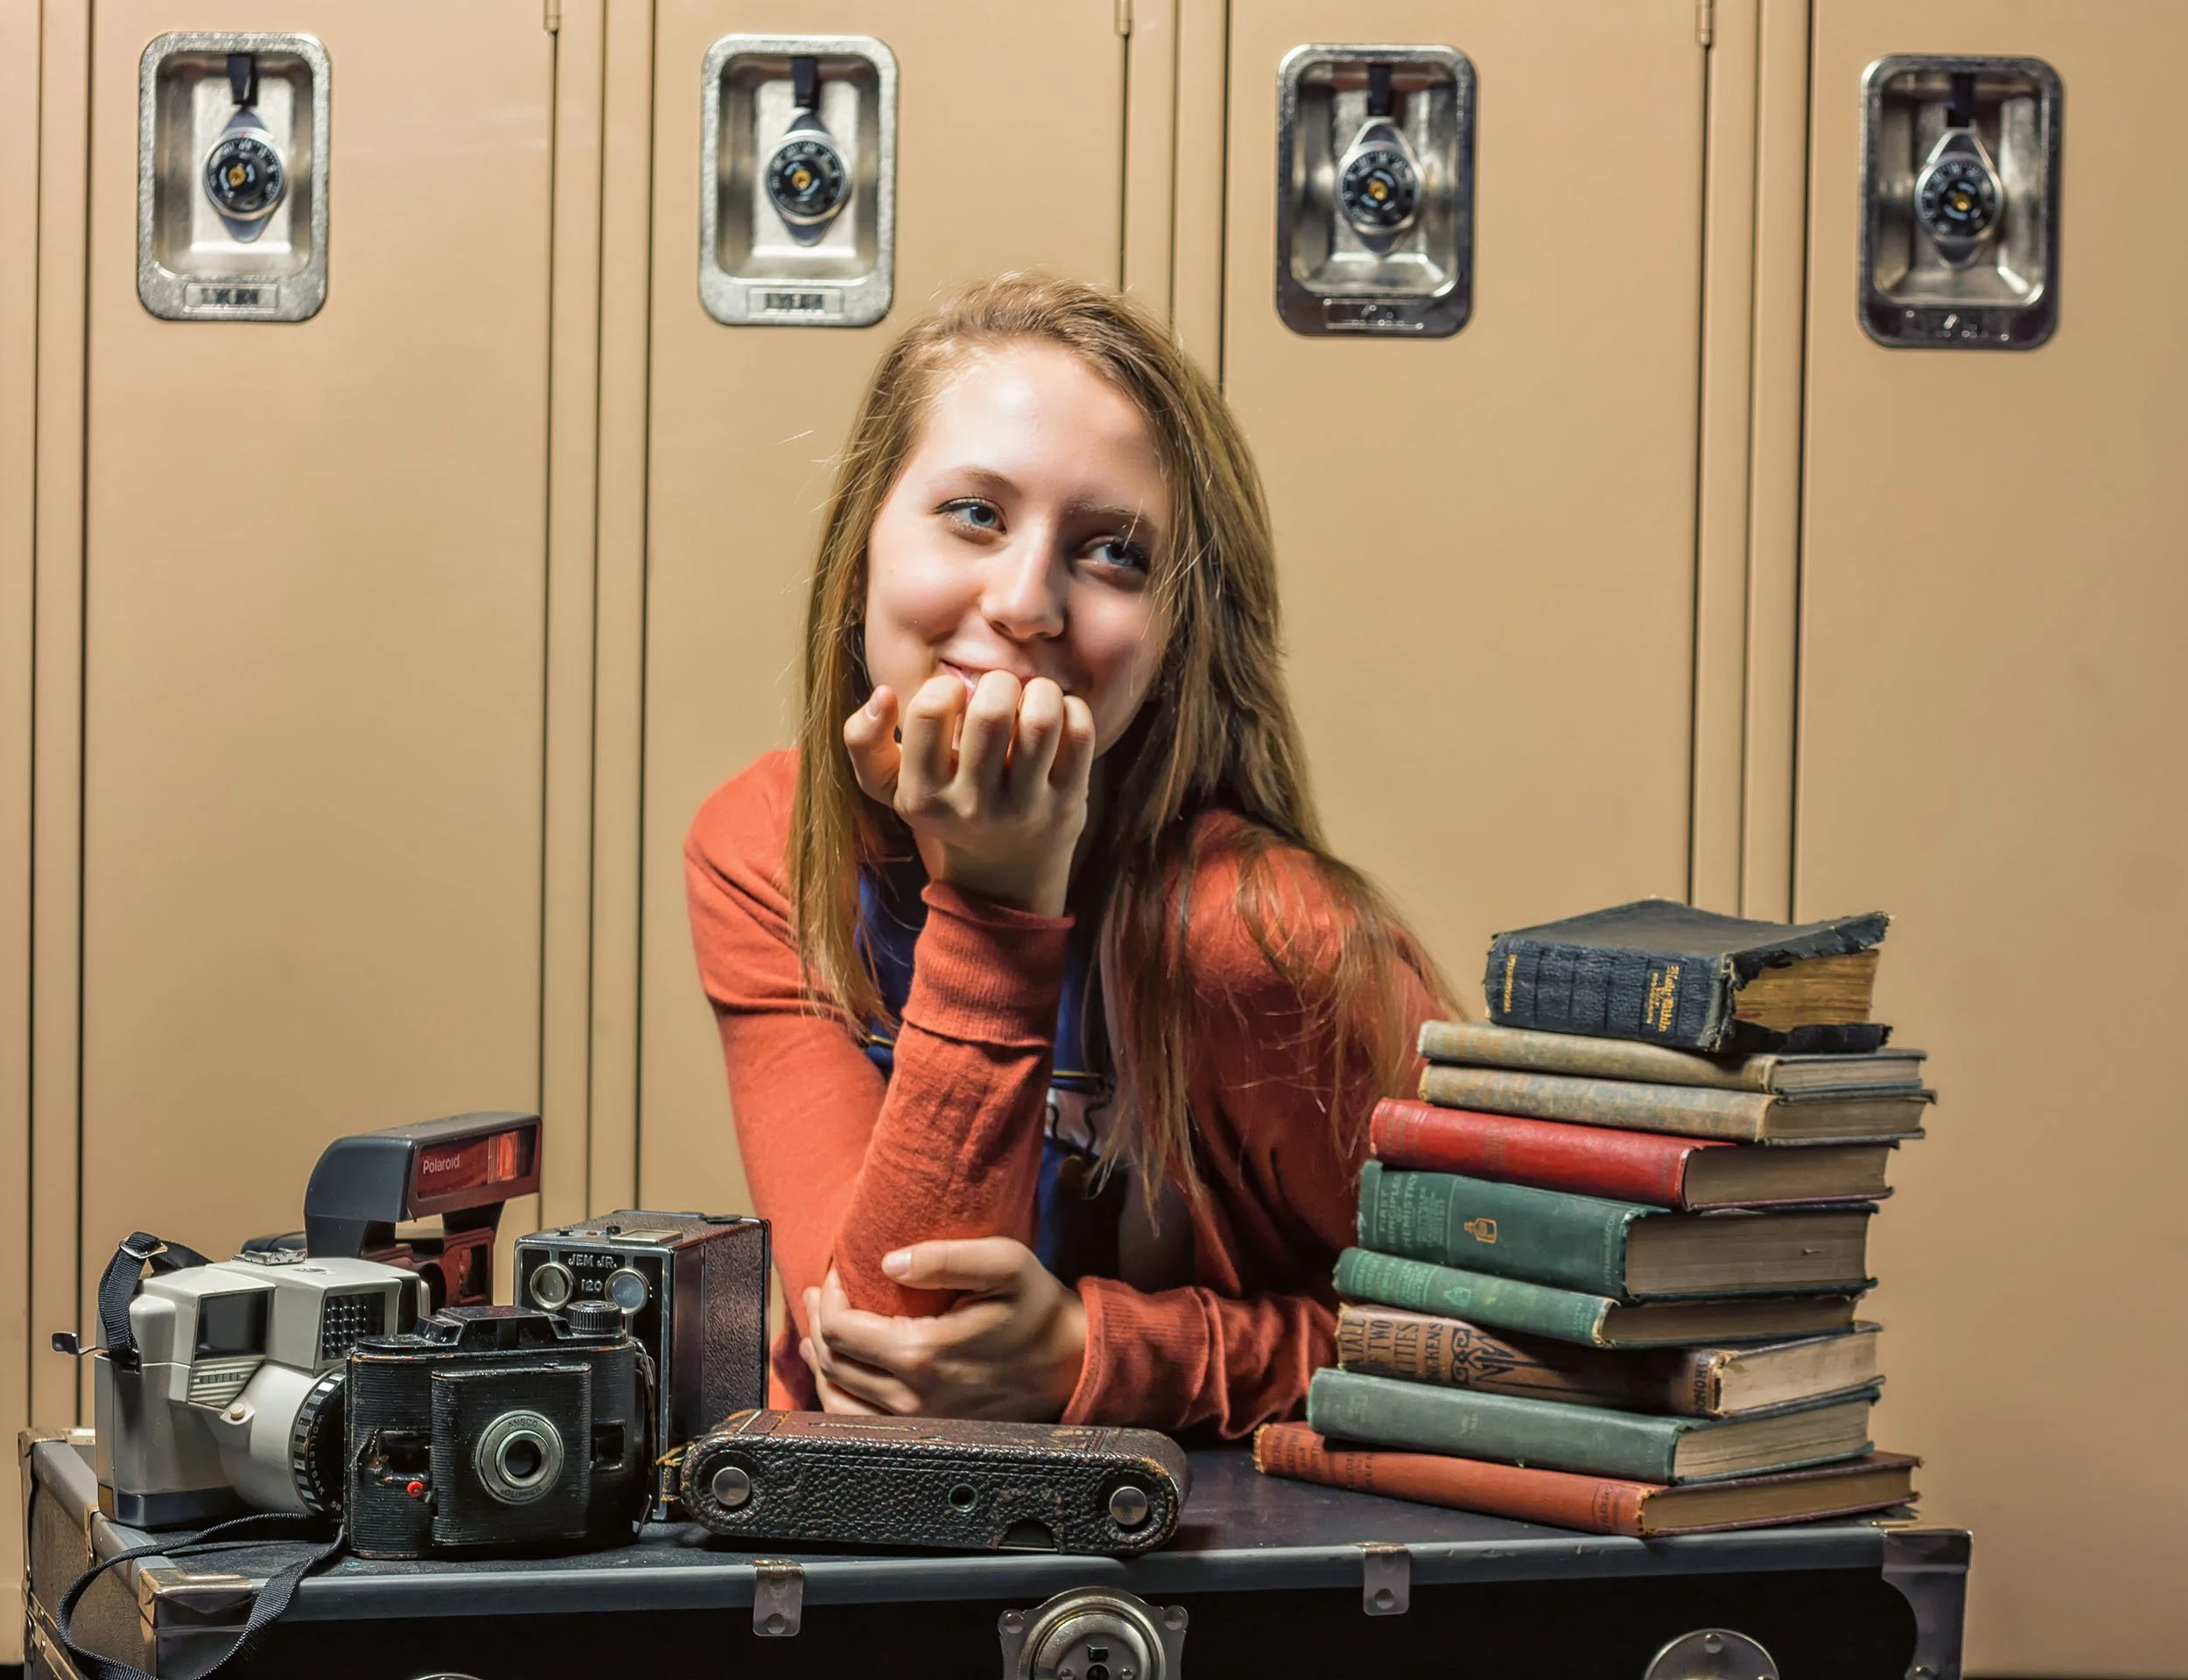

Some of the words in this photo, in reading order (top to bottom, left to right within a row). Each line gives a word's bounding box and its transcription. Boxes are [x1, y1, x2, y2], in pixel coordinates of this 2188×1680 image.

[423, 1154, 460, 1174] Polaroid
[1387, 1173, 1403, 1248] RINCIPLES
[1402, 1172, 1419, 1248] HEMISTRY
[568, 1253, 593, 1267] JEM
[596, 1256, 618, 1269] JR.
[580, 1278, 604, 1292] 120
[1341, 1319, 1366, 1354] TALE
[1367, 1320, 1393, 1351] TWO
[200, 1372, 240, 1383] REVERE
[508, 1418, 538, 1428] ANSCO
[309, 1414, 325, 1495] WOLLENSAK
[504, 1486, 543, 1499] CLIPPER
